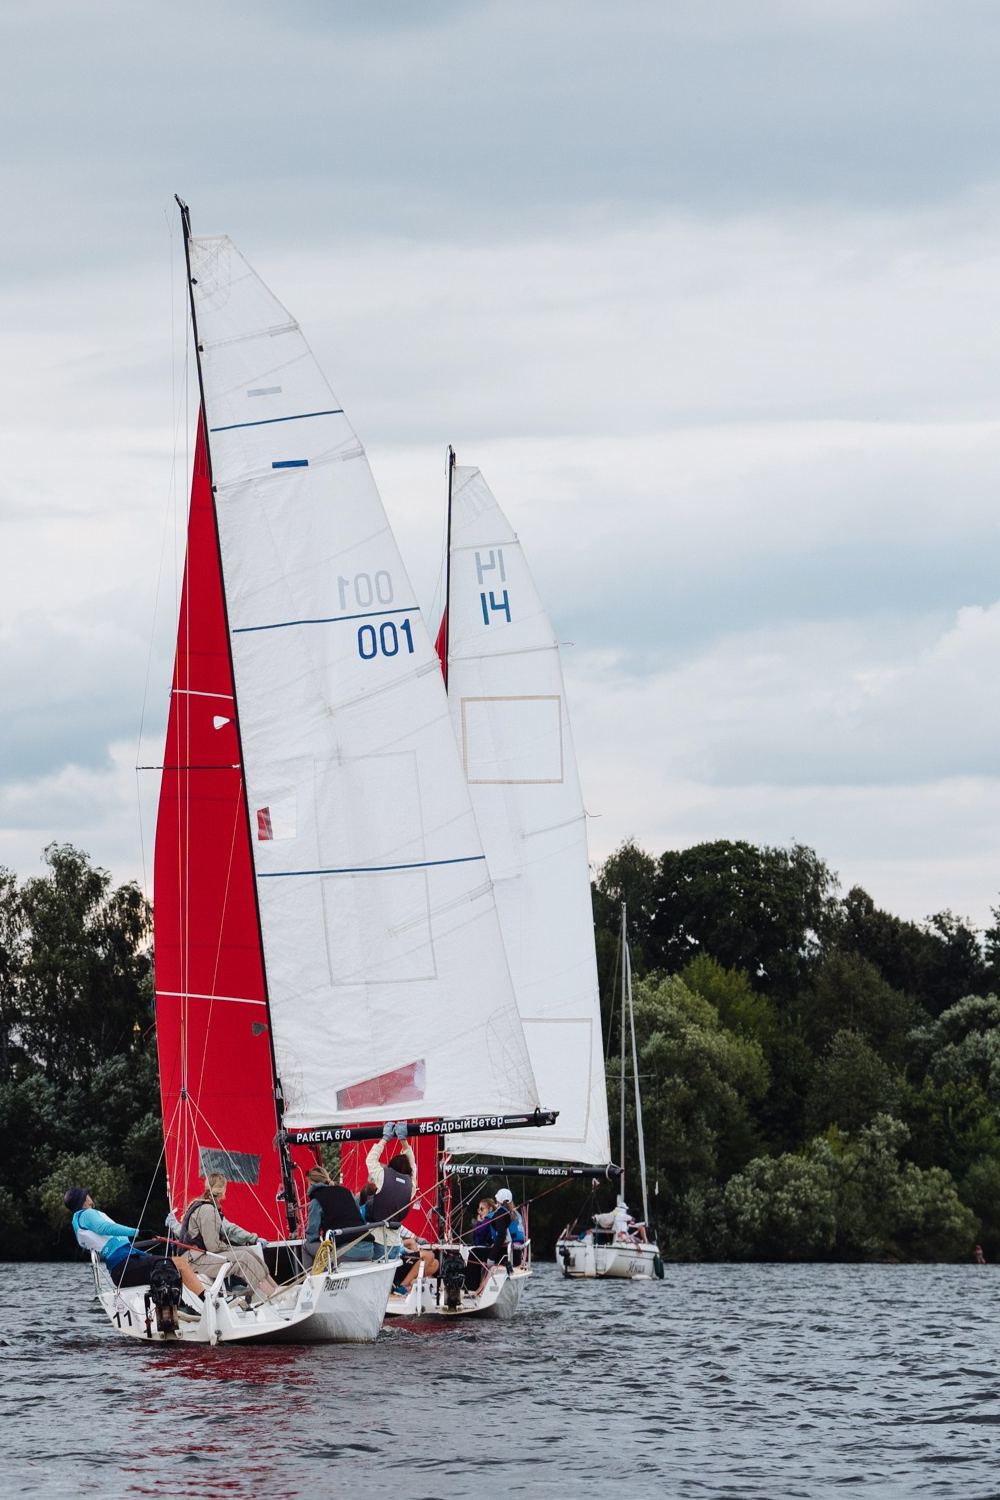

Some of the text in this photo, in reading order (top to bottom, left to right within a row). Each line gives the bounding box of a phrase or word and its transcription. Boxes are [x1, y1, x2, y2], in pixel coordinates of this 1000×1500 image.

[480, 590, 512, 626] 14
[357, 619, 415, 660] 001
[419, 1116, 503, 1134] #БодрыйВетер
[334, 1129, 351, 1140] 670
[475, 1166, 489, 1175] 670
[113, 1310, 132, 1328] 11
